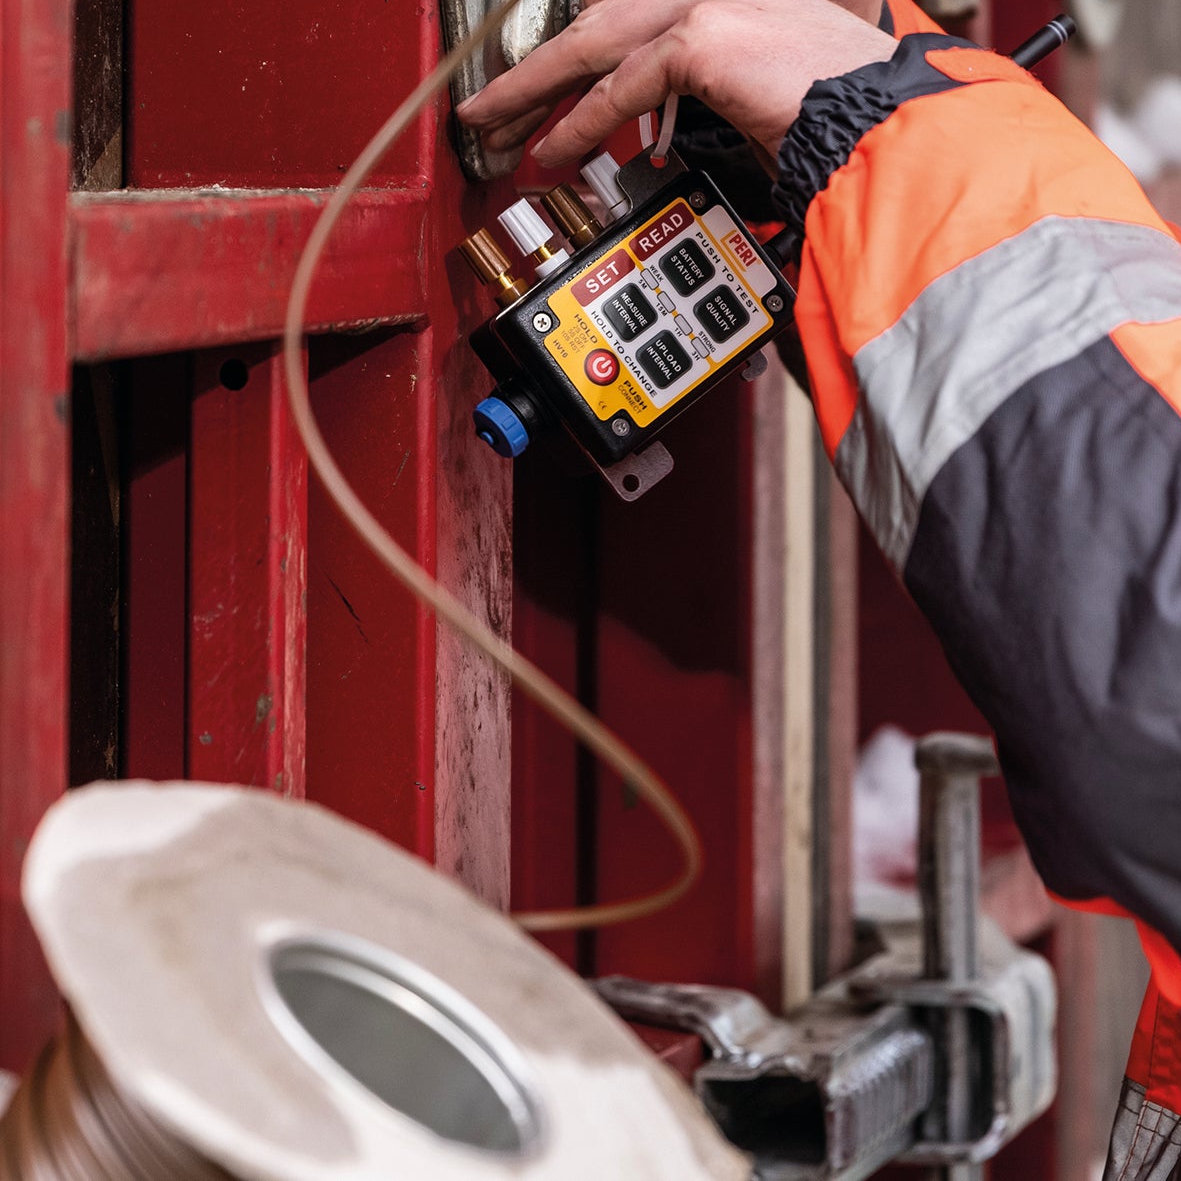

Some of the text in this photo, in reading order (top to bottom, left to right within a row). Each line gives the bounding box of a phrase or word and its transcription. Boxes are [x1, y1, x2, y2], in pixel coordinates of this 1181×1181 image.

[638, 212, 684, 252] READ
[678, 248, 704, 279] BATTERY
[728, 233, 757, 266] PERI
[584, 260, 622, 294] SET
[649, 264, 663, 282] WEAK
[670, 254, 695, 286] STATUS
[695, 231, 758, 315] PUSH TO TEST
[612, 299, 638, 333] INTERVAL
[620, 292, 647, 326] MEASURE
[705, 301, 729, 332] QUALITY
[714, 295, 738, 325] SIGNAL
[574, 313, 598, 344] HOLD
[698, 330, 716, 353] STRONG
[590, 310, 657, 398] HOLD TO CHANGE
[646, 345, 673, 379] INTERVAL
[654, 339, 682, 373] UPLOAD
[617, 384, 641, 414] CONNECT
[623, 380, 647, 410] PUSH
